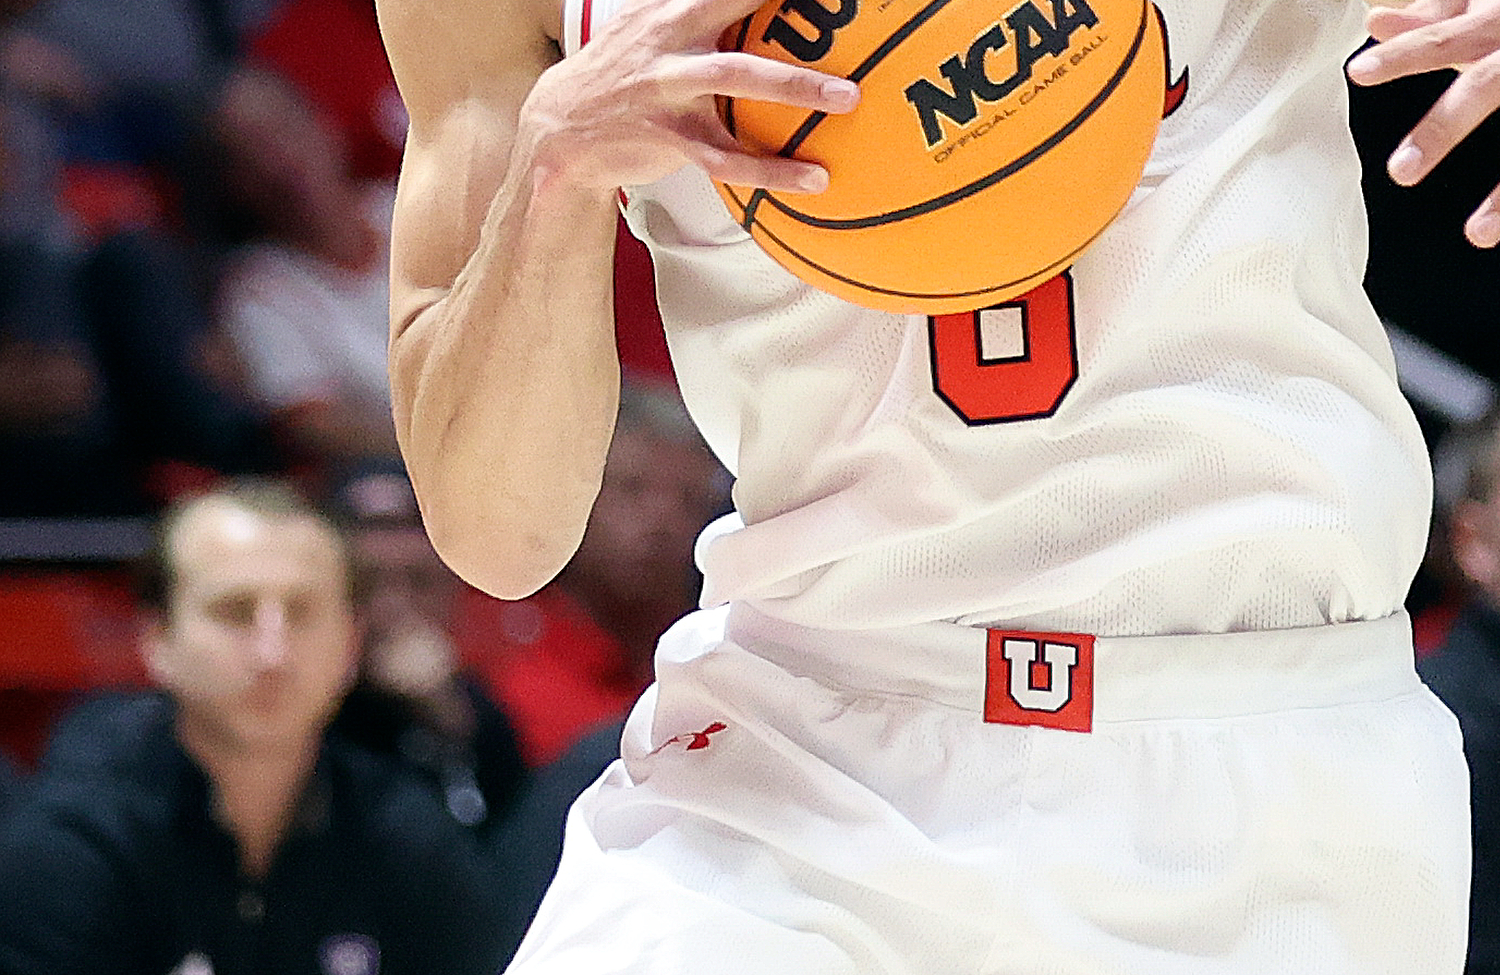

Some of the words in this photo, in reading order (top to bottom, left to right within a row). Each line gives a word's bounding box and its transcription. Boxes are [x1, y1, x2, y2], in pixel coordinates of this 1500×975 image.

[933, 107, 1017, 164] OFFICIAL
[1009, 64, 1067, 106] GAME
[1069, 34, 1109, 66] BALL
[1002, 637, 1080, 713] U
